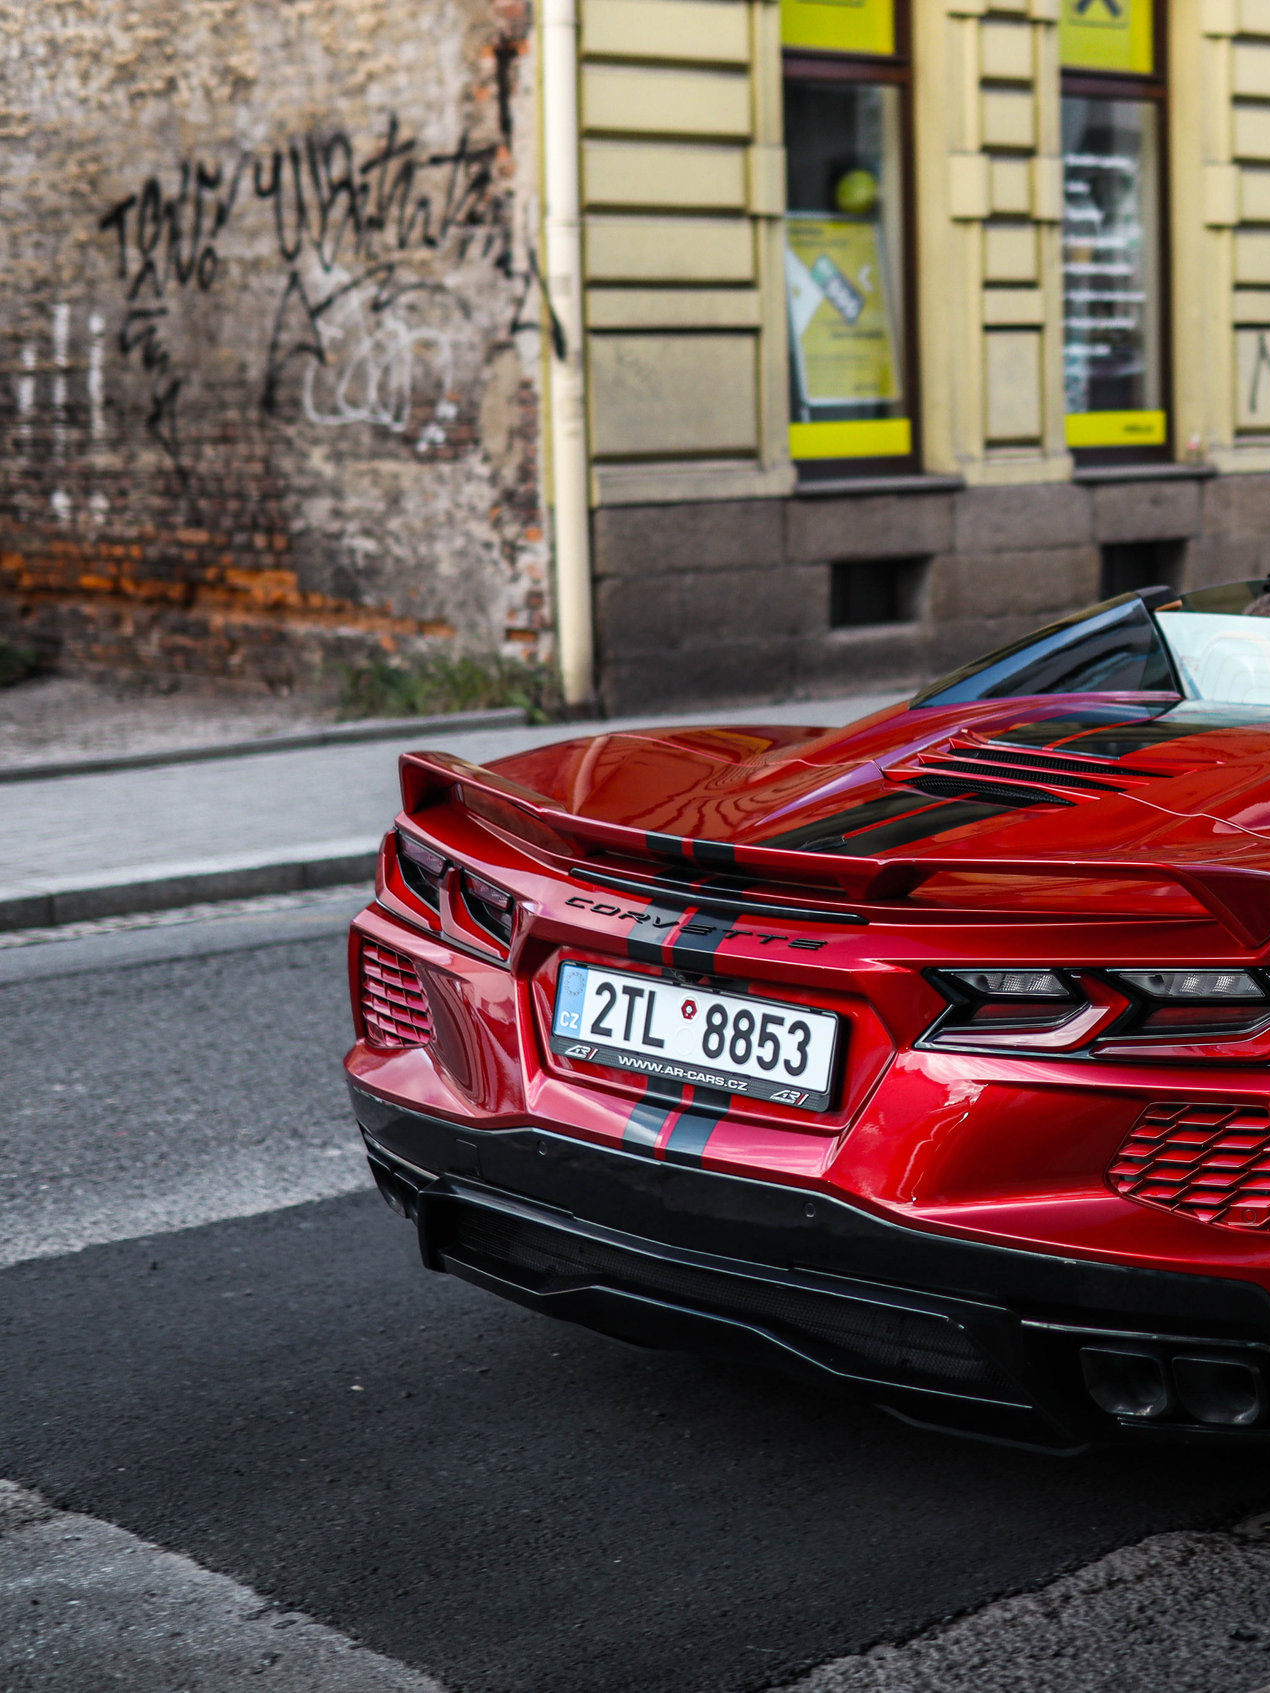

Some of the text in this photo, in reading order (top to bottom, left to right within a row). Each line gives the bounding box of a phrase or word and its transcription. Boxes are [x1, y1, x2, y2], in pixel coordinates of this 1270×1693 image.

[564, 896, 828, 950] CORVETTE
[560, 1010, 580, 1030] CZ
[590, 981, 812, 1076] 2TL 8853
[618, 1055, 748, 1091] WWW.AR-CARS.CZ
